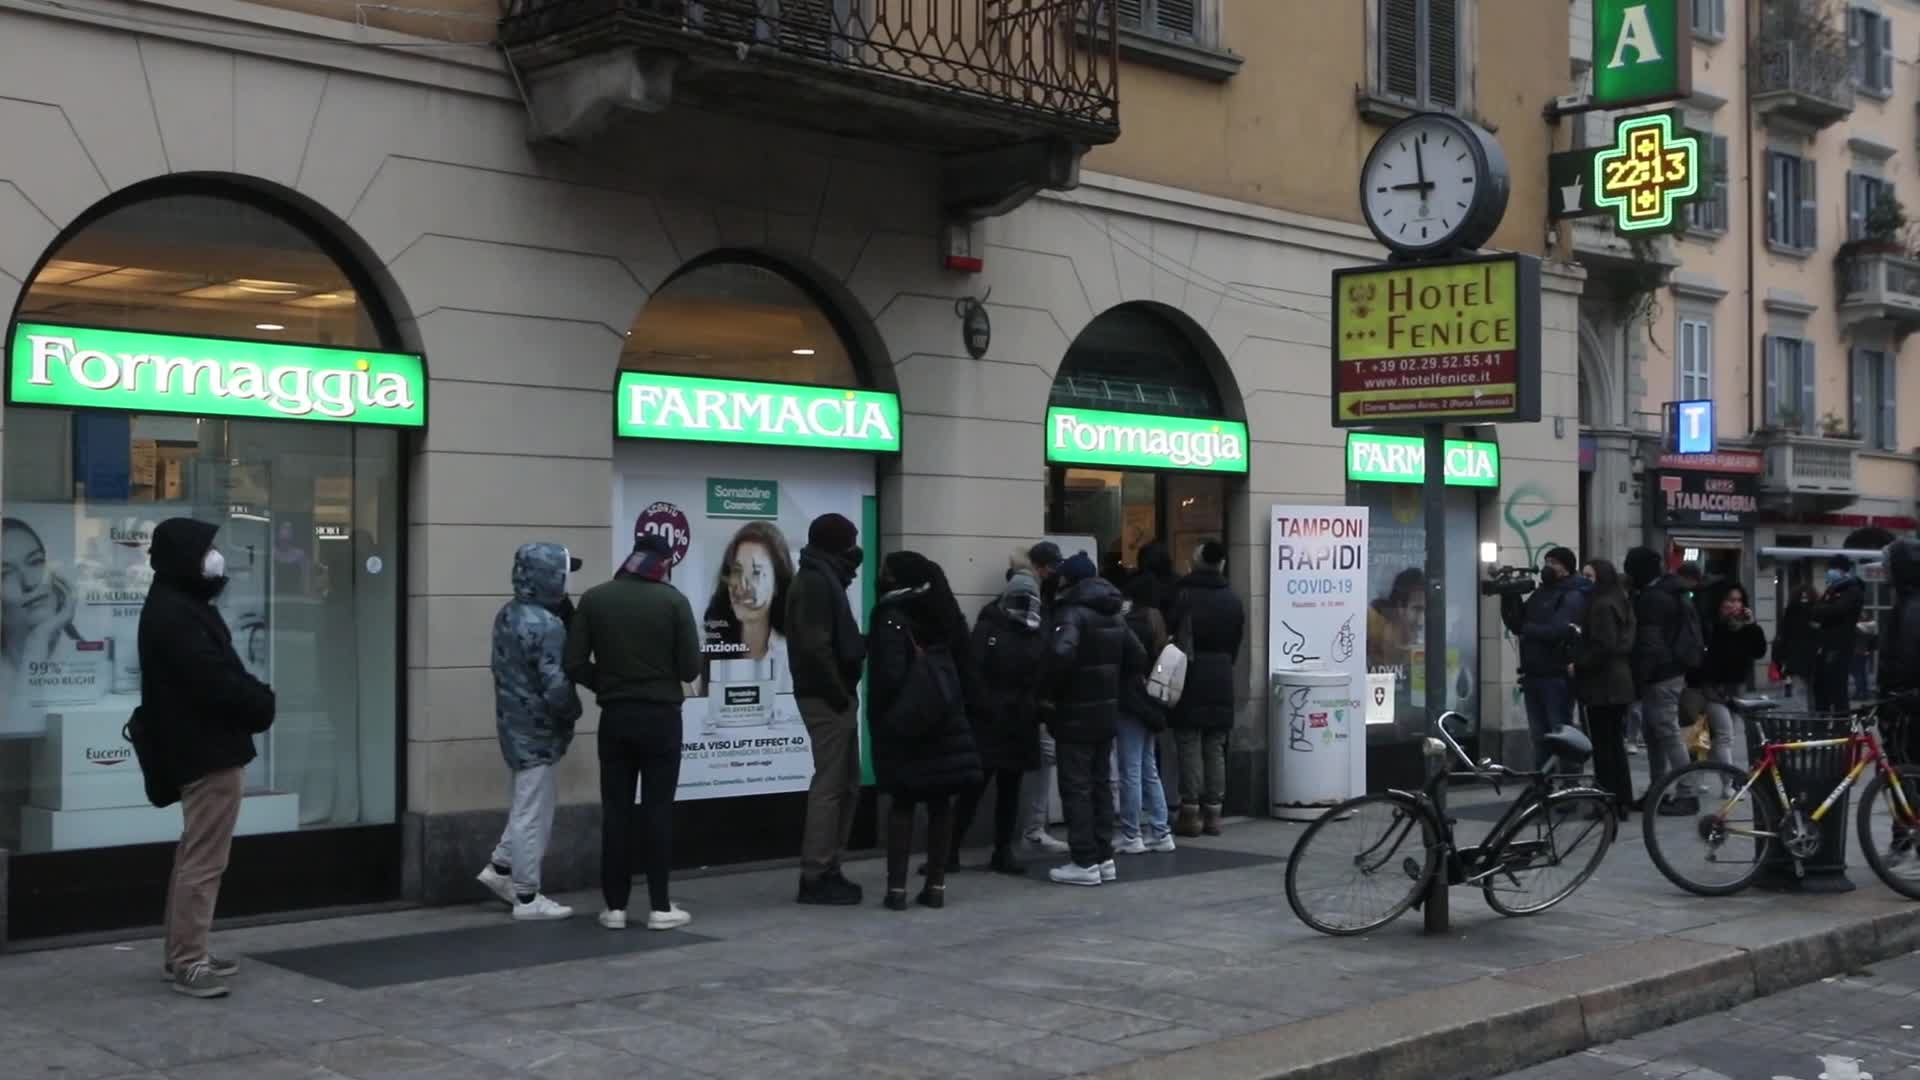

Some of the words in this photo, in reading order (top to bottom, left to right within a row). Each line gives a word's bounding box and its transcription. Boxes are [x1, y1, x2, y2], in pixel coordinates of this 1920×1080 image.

[1606, 4, 1663, 69] A
[1606, 152, 1686, 190] 22:13
[1371, 359, 1396, 373] +39
[1400, 353, 1501, 371] 02.29.52.55.41
[27, 335, 415, 418] Formaggia
[1364, 371, 1491, 389] www.hotelfenice.it
[628, 384, 894, 440] FARMACIA
[1684, 407, 1704, 439] T
[1054, 414, 1243, 467] Formaggia
[1352, 441, 1495, 478] FARMCIA
[714, 485, 770, 499] Somatoline
[1277, 517, 1363, 538] TAMPONI
[1278, 544, 1361, 570] RAPIDI
[1287, 579, 1352, 594] COVID-19
[700, 641, 750, 652] unziona.
[29, 662, 62, 675] 99%
[86, 746, 131, 760] Eucerin
[708, 740, 731, 750] VISO
[733, 738, 753, 748] LIFT
[755, 737, 788, 747] EFFECT
